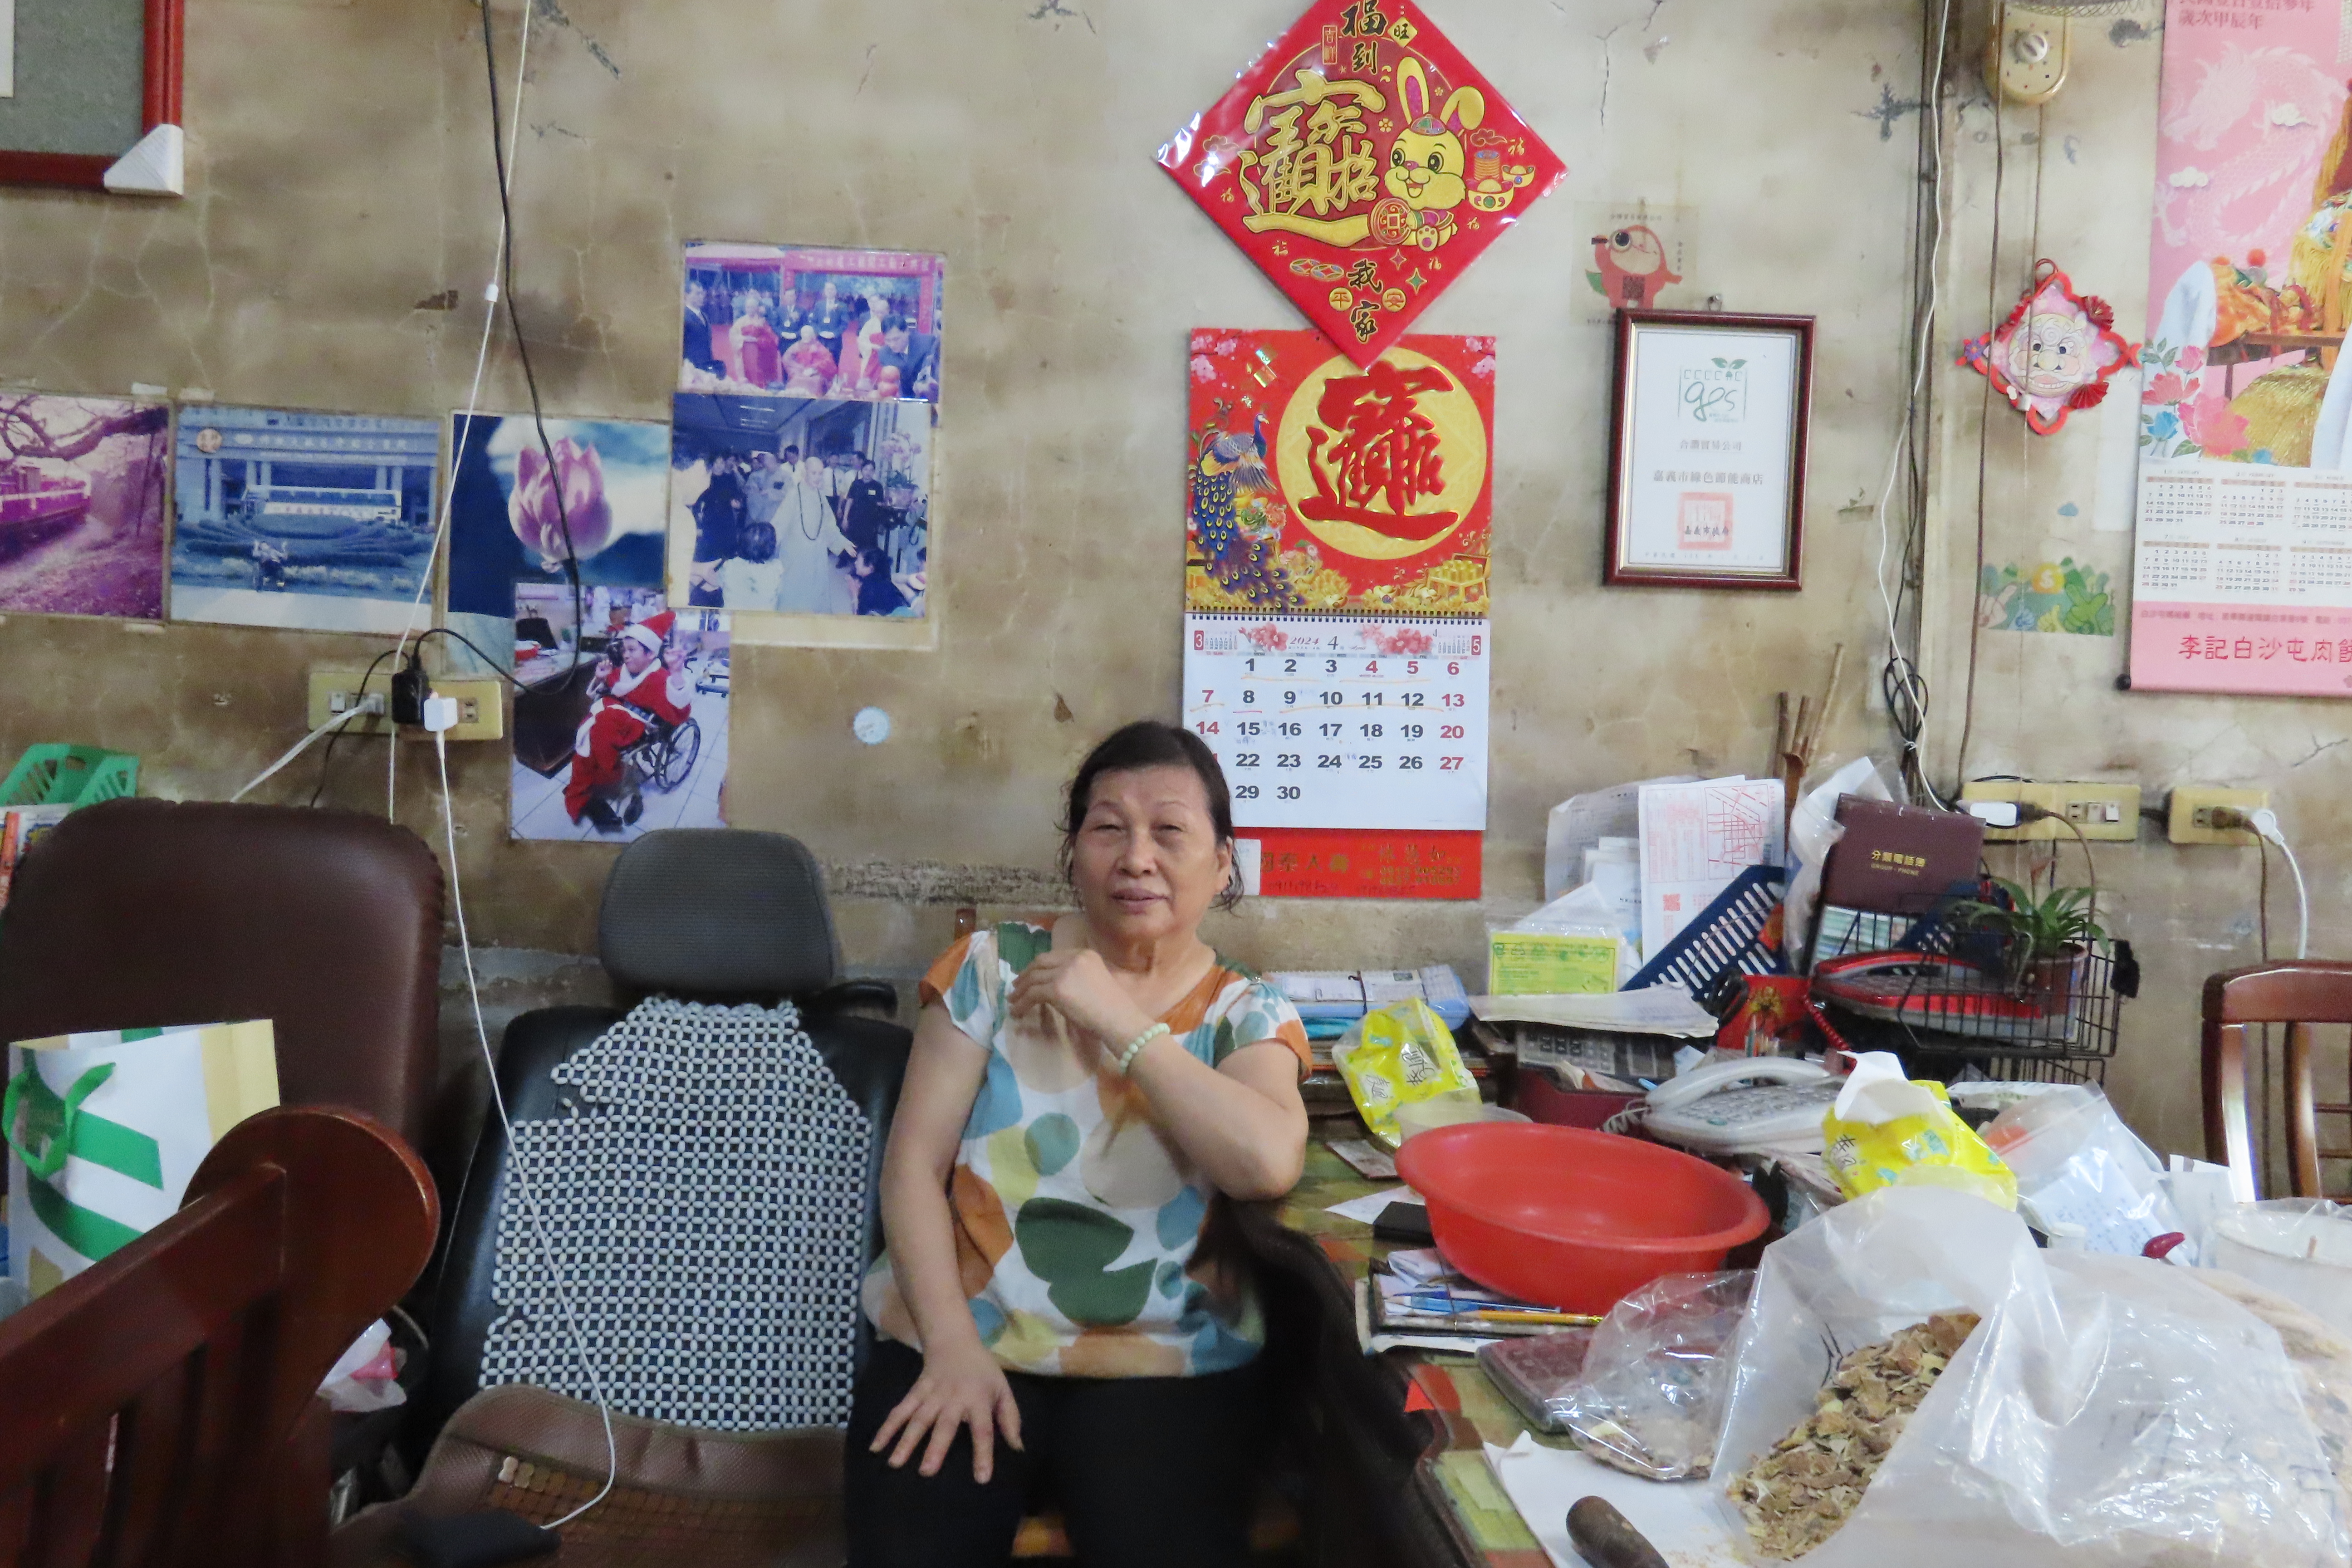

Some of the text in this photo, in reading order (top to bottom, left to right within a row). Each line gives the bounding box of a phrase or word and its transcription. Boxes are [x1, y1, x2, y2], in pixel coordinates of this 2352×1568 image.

[1196, 633, 1203, 648] 3
[1289, 637, 1319, 645] 2024
[1328, 636, 1339, 650] 4
[1473, 639, 1480, 653] 5
[1245, 658, 1459, 675] 1 2 3 4 5 6
[1202, 690, 1464, 706] 7 8 9 10 11 12 13
[1196, 721, 1219, 734] 14
[1237, 722, 1260, 735] 15
[1278, 723, 1301, 735] 16
[1319, 724, 1342, 736] 17
[1360, 724, 1382, 737] 18
[1401, 725, 1423, 738] 19
[1440, 725, 1464, 738] 20
[1236, 754, 1259, 766] 22
[1277, 755, 1301, 767] 23
[1318, 755, 1342, 768] 24
[1359, 755, 1382, 769] 25
[1399, 756, 1422, 769] 26
[1440, 757, 1464, 769] 27
[1235, 786, 1300, 799] 29 30
